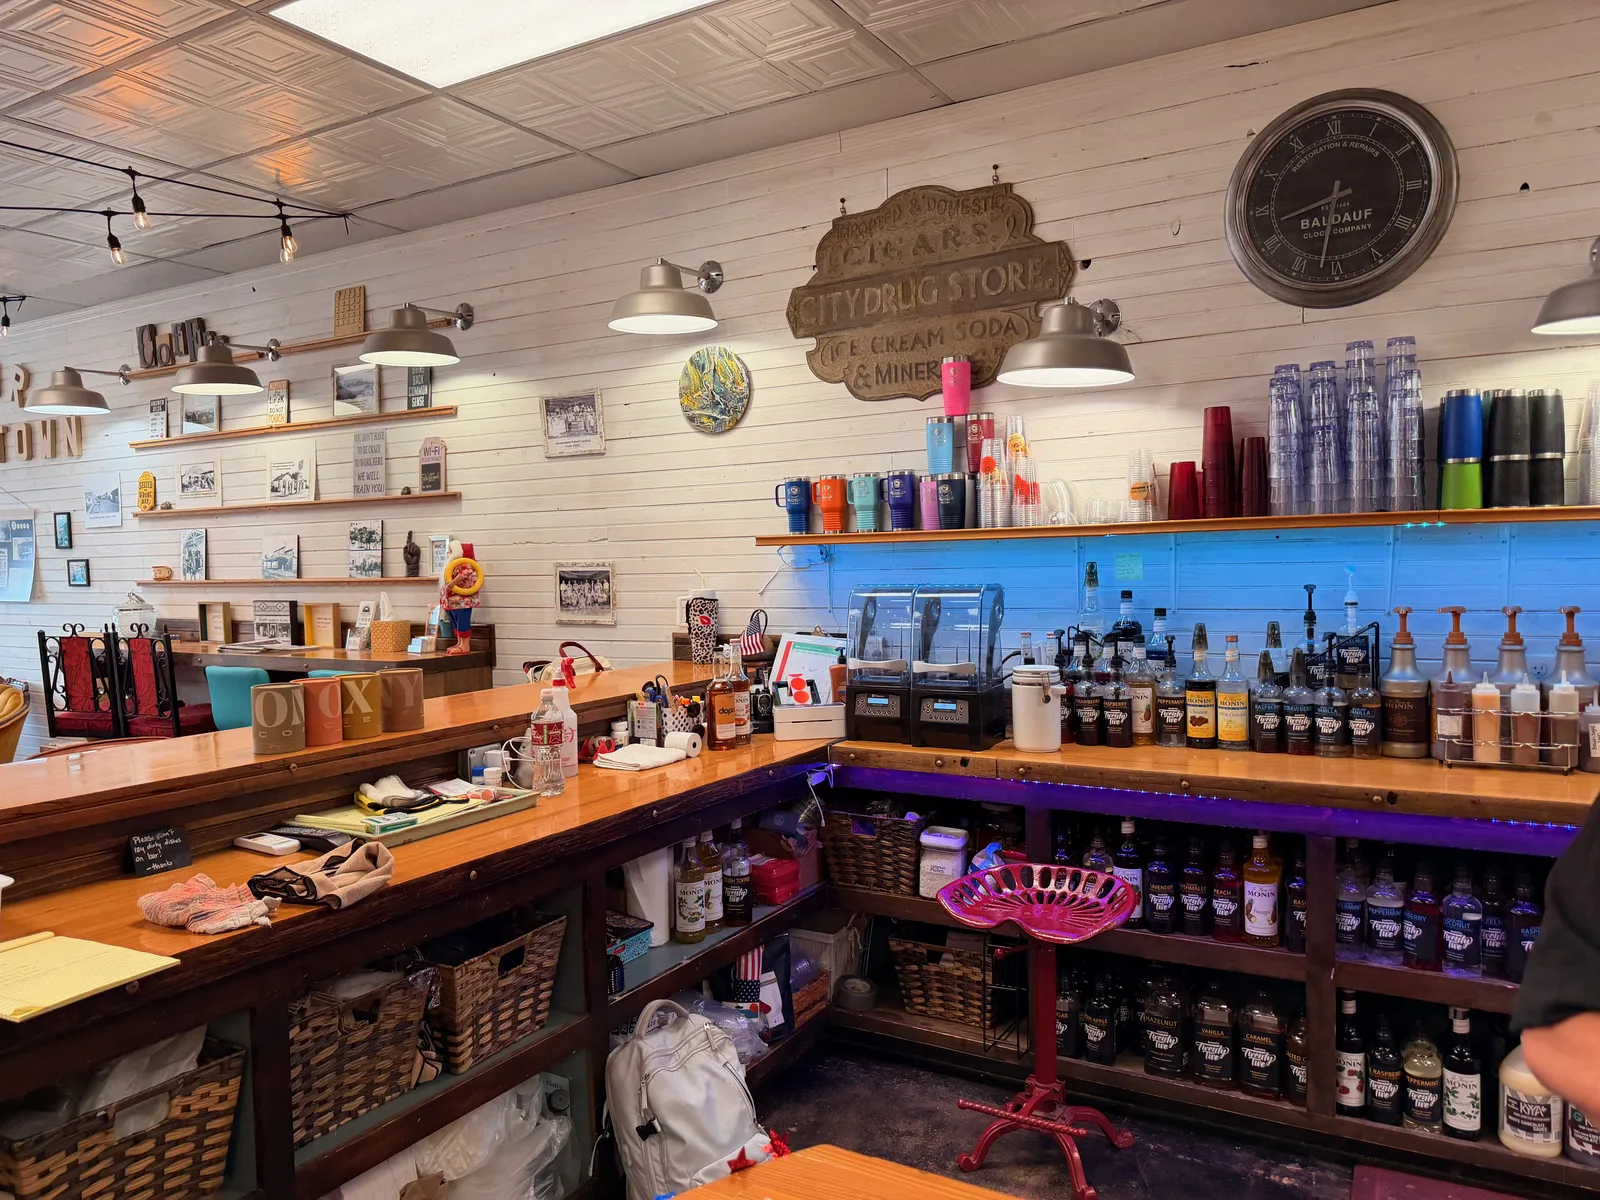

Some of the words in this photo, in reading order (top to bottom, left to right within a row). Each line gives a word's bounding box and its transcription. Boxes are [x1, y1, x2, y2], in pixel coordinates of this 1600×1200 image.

[1292, 141, 1341, 173] RESTORATION
[1349, 141, 1381, 159] REPAIRS
[1300, 208, 1373, 230] BALDAUF
[1303, 229, 1329, 240] CLOC
[1332, 222, 1373, 235] COMPANY
[829, 340, 857, 364] ICE
[870, 326, 944, 355] CREAM
[955, 316, 1020, 341] SODA
[852, 363, 872, 391] &
[353, 484, 371, 495] TRAIN
[1385, 702, 1414, 710] MONIN
[132, 834, 155, 845] Please
[156, 828, 175, 841] don't
[146, 841, 163, 851] dirty
[135, 855, 144, 863] on
[147, 848, 163, 860] bar!
[679, 887, 704, 896] MONIN
[1213, 888, 1232, 896] PEACH
[1247, 889, 1276, 898] MONIN
[1145, 1015, 1178, 1028] HAZELNUT
[1201, 1027, 1225, 1037] VANILLA
[1245, 1032, 1273, 1045] CARAMEL
[1446, 1078, 1478, 1090] MONIN
[1507, 1114, 1521, 1124] WHITE
[1520, 1119, 1546, 1128] CHOCOLATE
[1532, 1124, 1548, 1132] SAUCE
